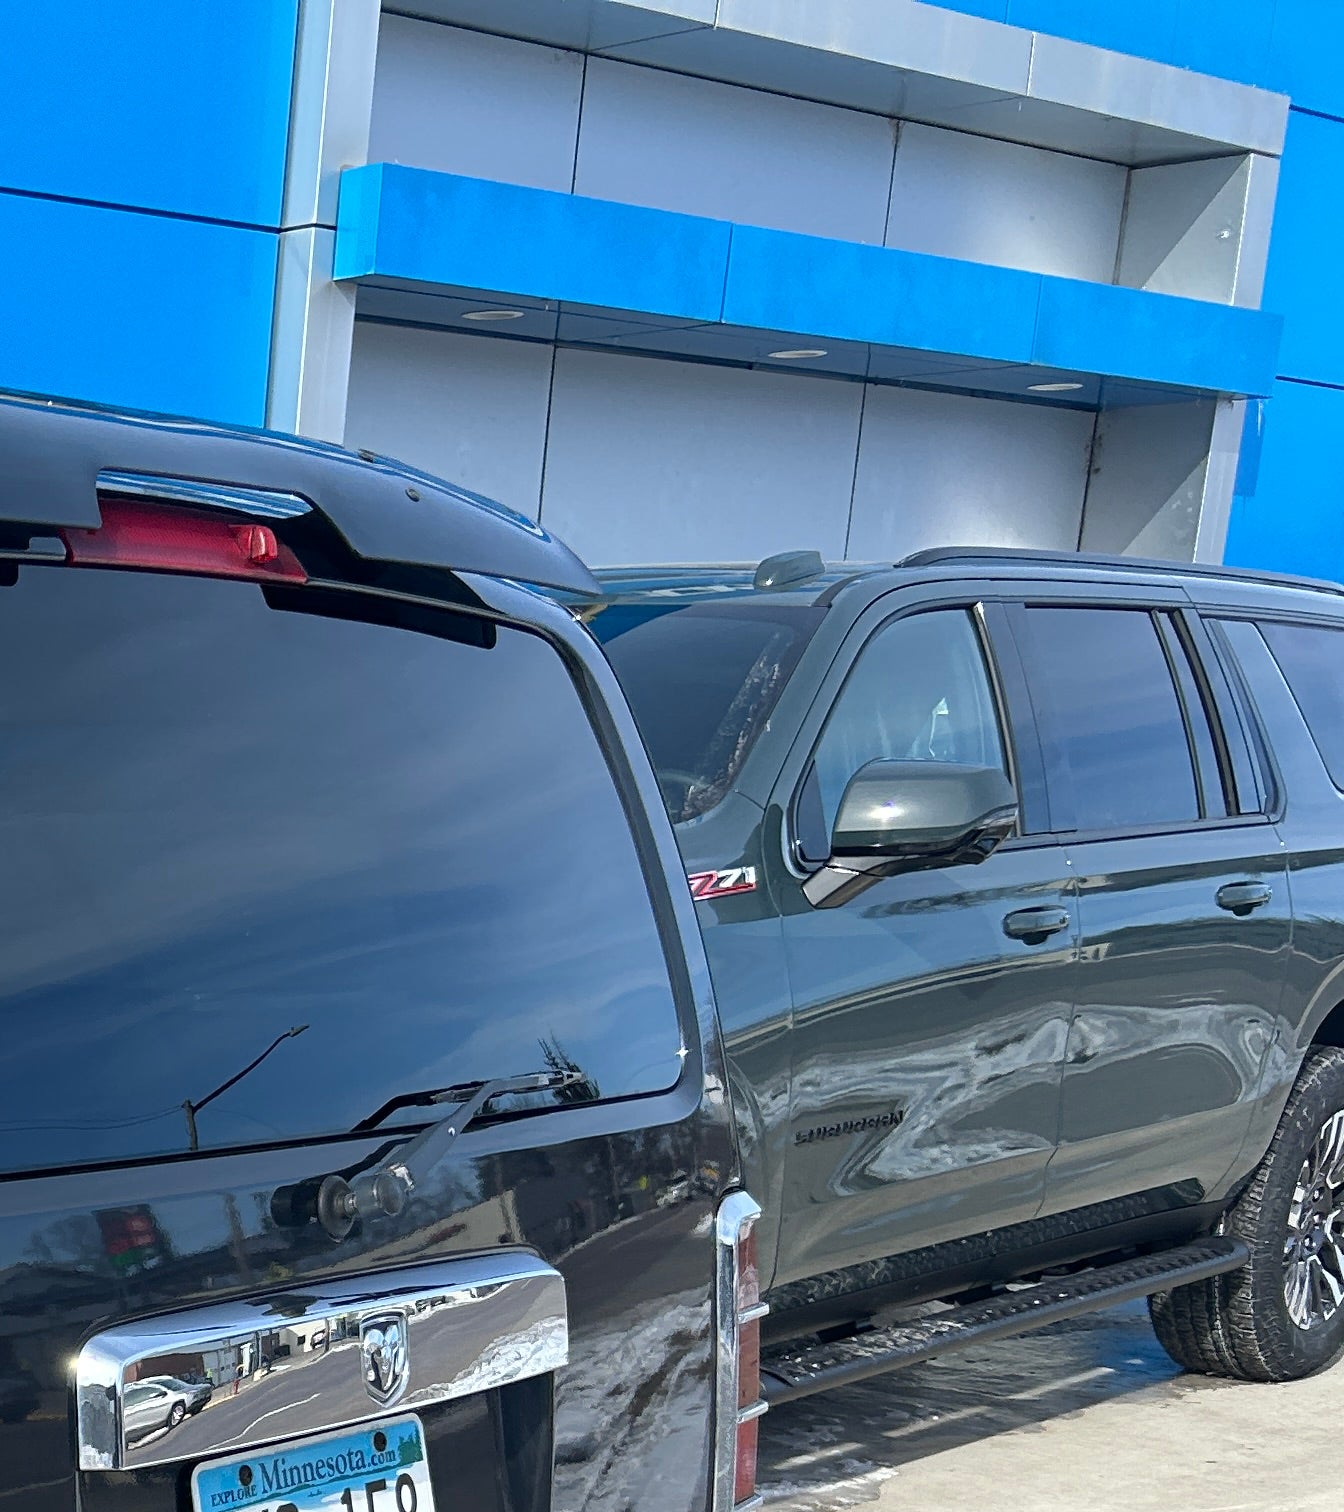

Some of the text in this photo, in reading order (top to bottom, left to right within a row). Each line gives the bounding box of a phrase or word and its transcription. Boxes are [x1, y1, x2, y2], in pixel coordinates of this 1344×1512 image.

[687, 866, 757, 901] Z71
[210, 1447, 397, 1507] EXPLORE Minnesota.com
